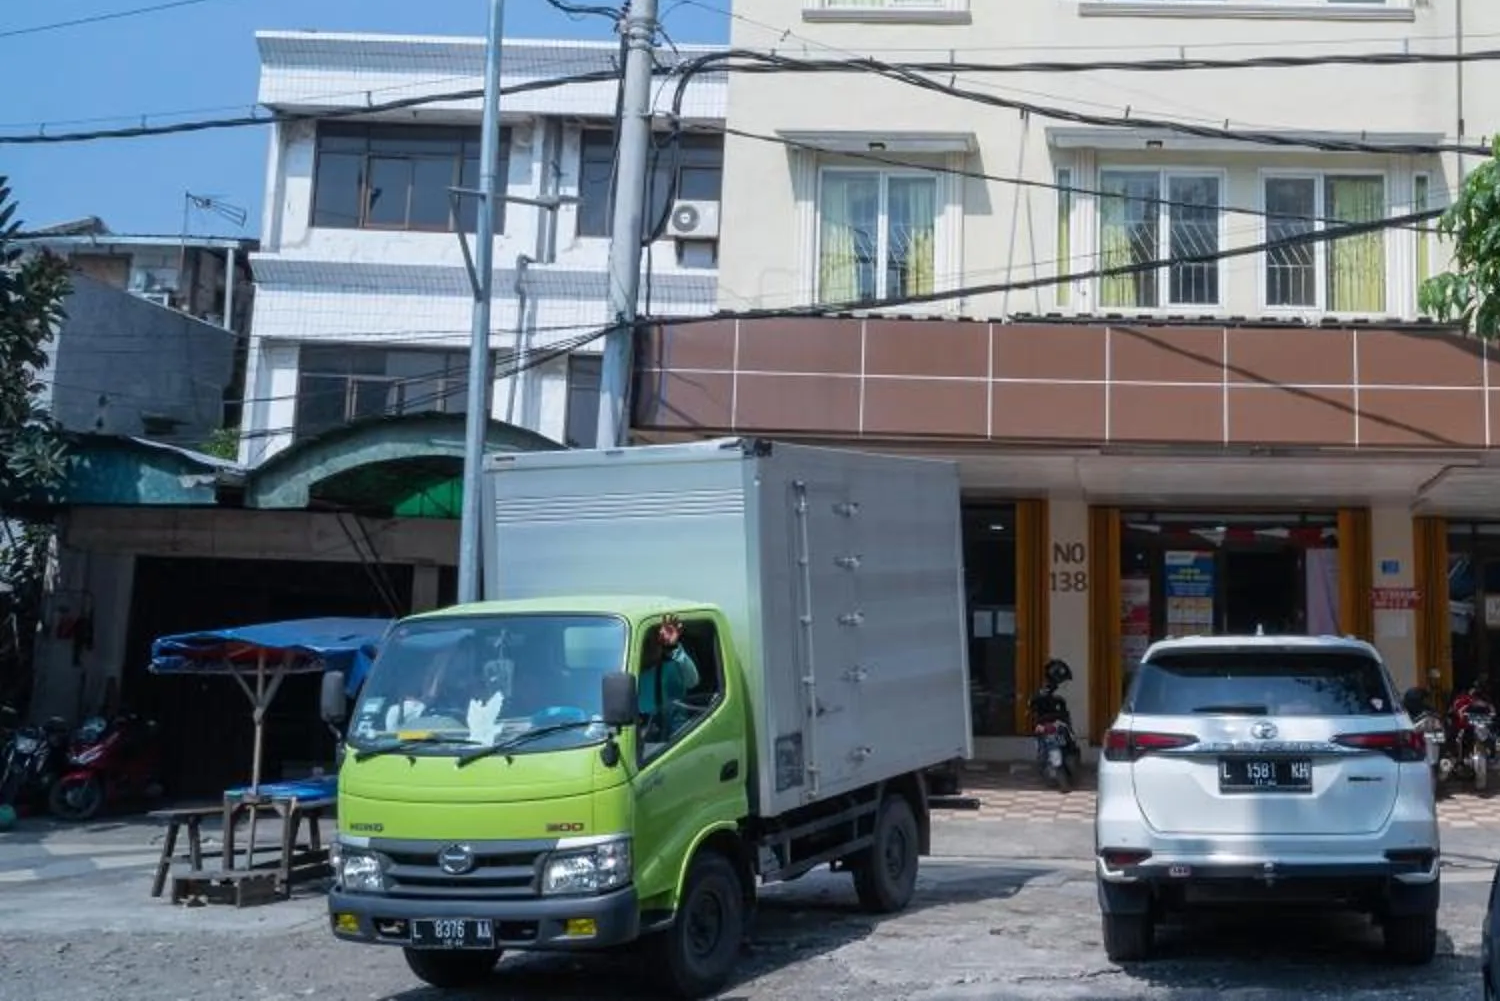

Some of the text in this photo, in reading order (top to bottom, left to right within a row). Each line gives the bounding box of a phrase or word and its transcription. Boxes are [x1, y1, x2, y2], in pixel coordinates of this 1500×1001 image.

[1053, 542, 1086, 565] NO
[1050, 570, 1088, 593] 138
[1223, 762, 1232, 779] L
[1247, 762, 1277, 779] 1581
[412, 921, 423, 939] L
[435, 918, 465, 939] 8376
